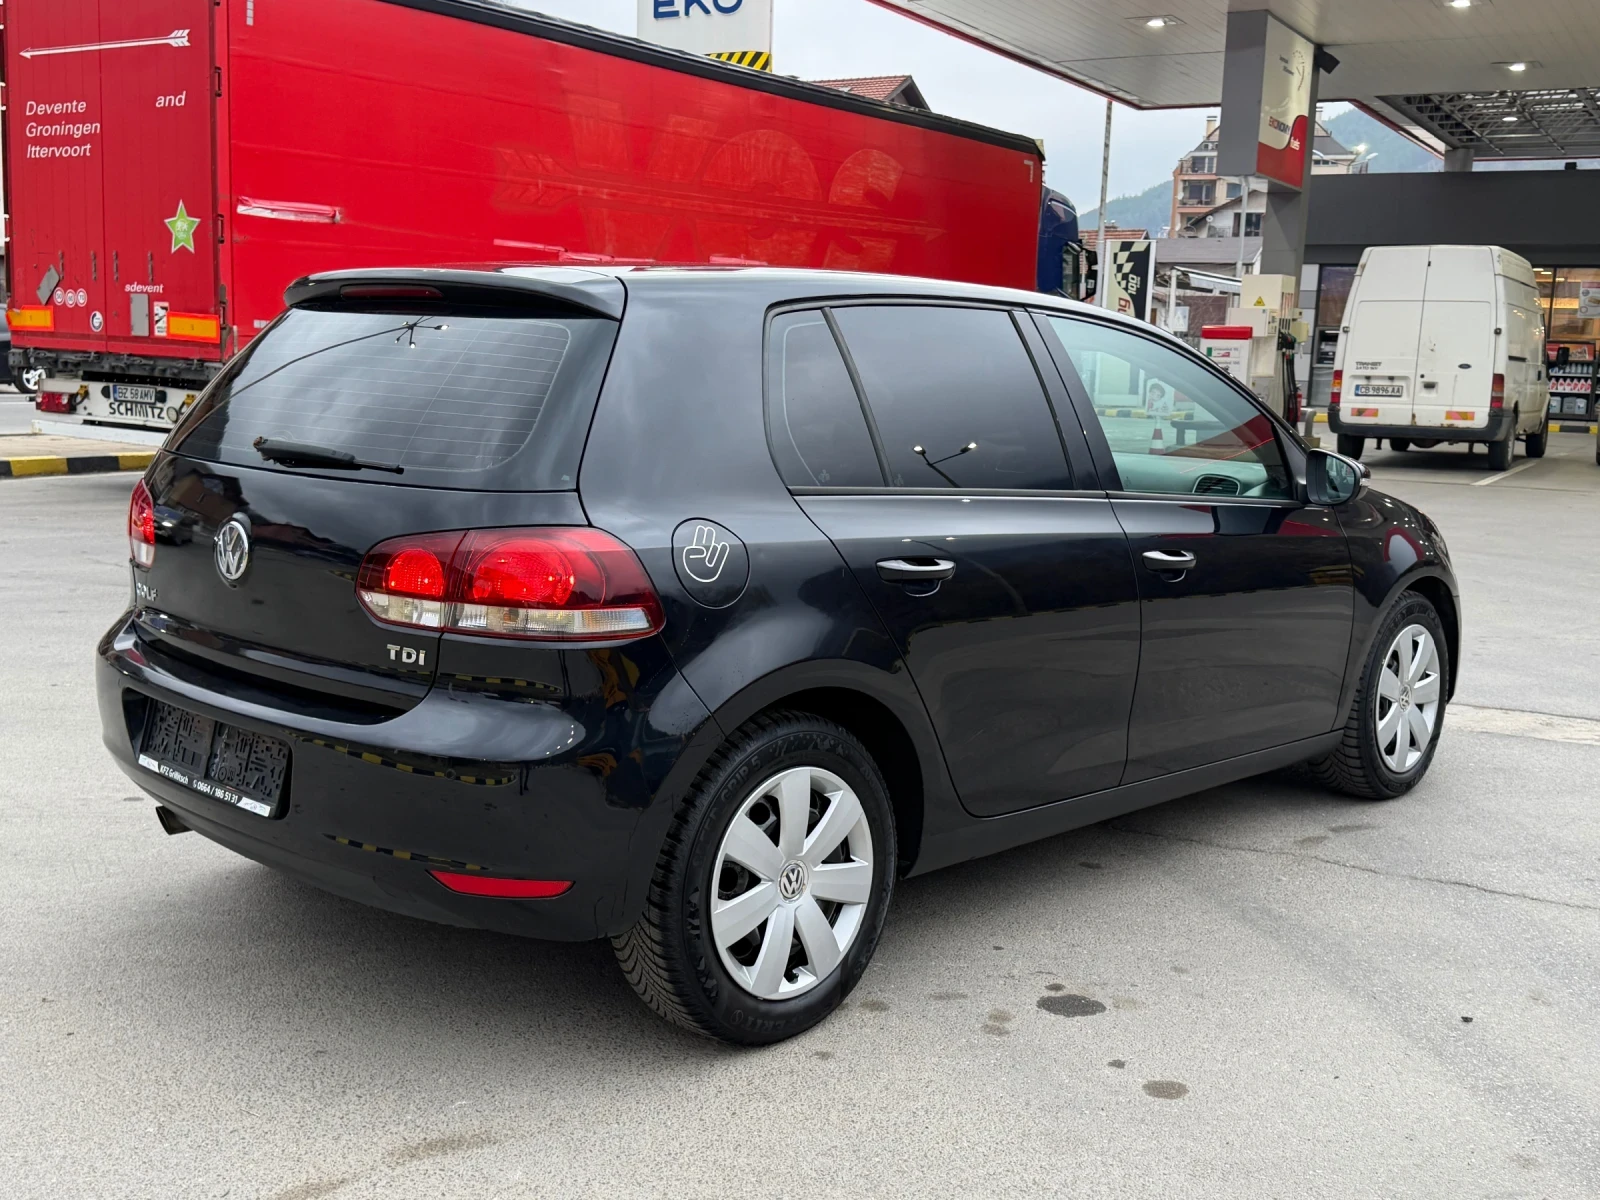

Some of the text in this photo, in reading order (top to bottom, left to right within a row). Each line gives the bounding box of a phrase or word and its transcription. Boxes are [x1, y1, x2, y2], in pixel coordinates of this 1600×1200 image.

[155, 91, 187, 108] and
[25, 100, 87, 116] Devente
[25, 121, 100, 138] Groningen
[26, 143, 92, 158] Ittervoort
[124, 282, 164, 294] sdevent
[1127, 273, 1137, 295] 100
[130, 388, 139, 400] 58
[1360, 386, 1370, 394] CB
[1371, 386, 1389, 394] 9896
[109, 402, 165, 420] SCHMITZ
[386, 643, 426, 666] TDI
[160, 764, 169, 776] KFZ
